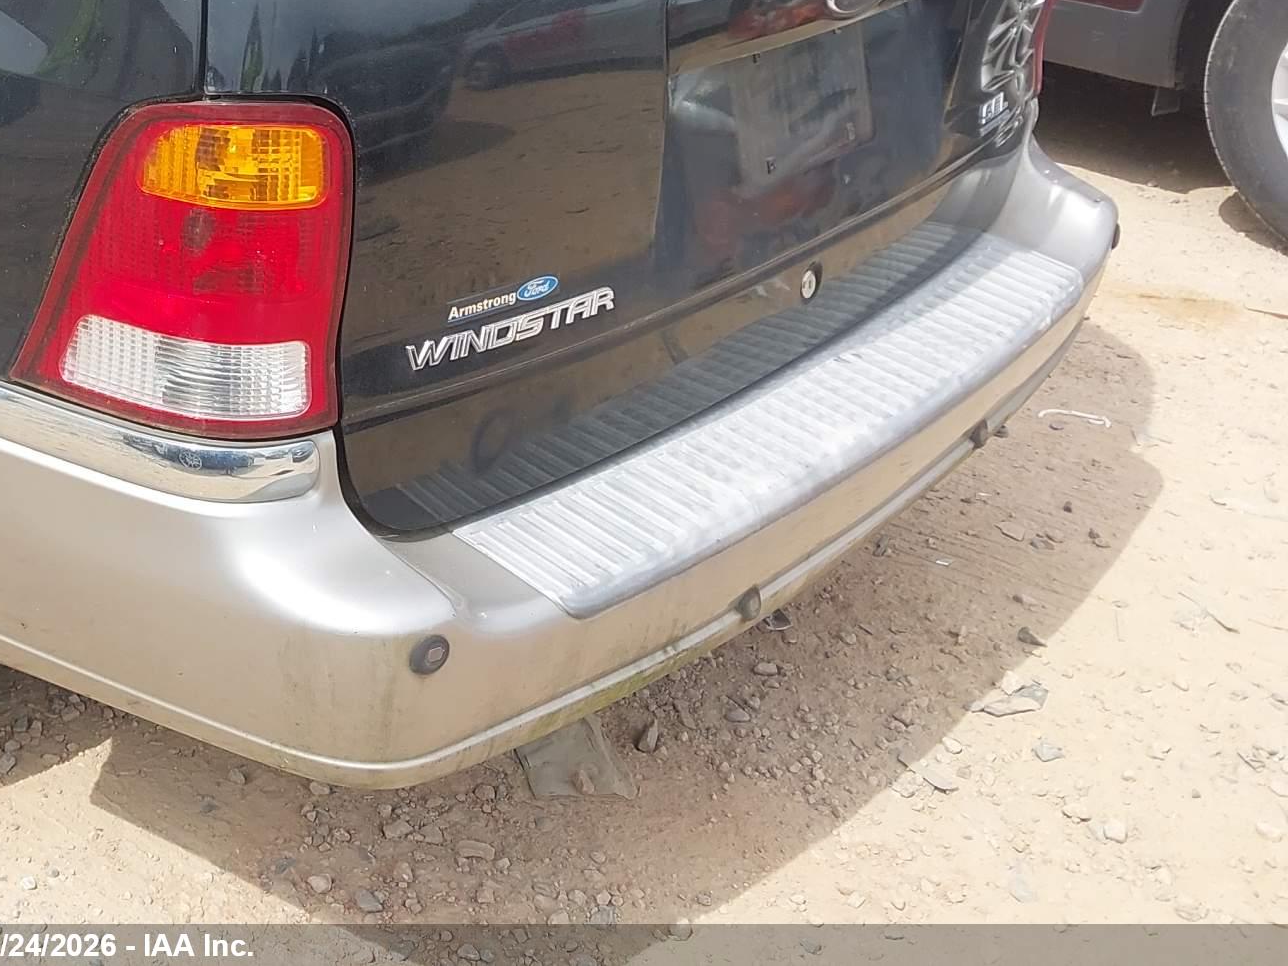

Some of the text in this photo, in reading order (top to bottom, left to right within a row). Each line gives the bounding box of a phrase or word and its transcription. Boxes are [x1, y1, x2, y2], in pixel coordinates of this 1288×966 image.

[405, 286, 616, 371] WINDSTAR
[448, 277, 555, 321] Armstrong Ford
